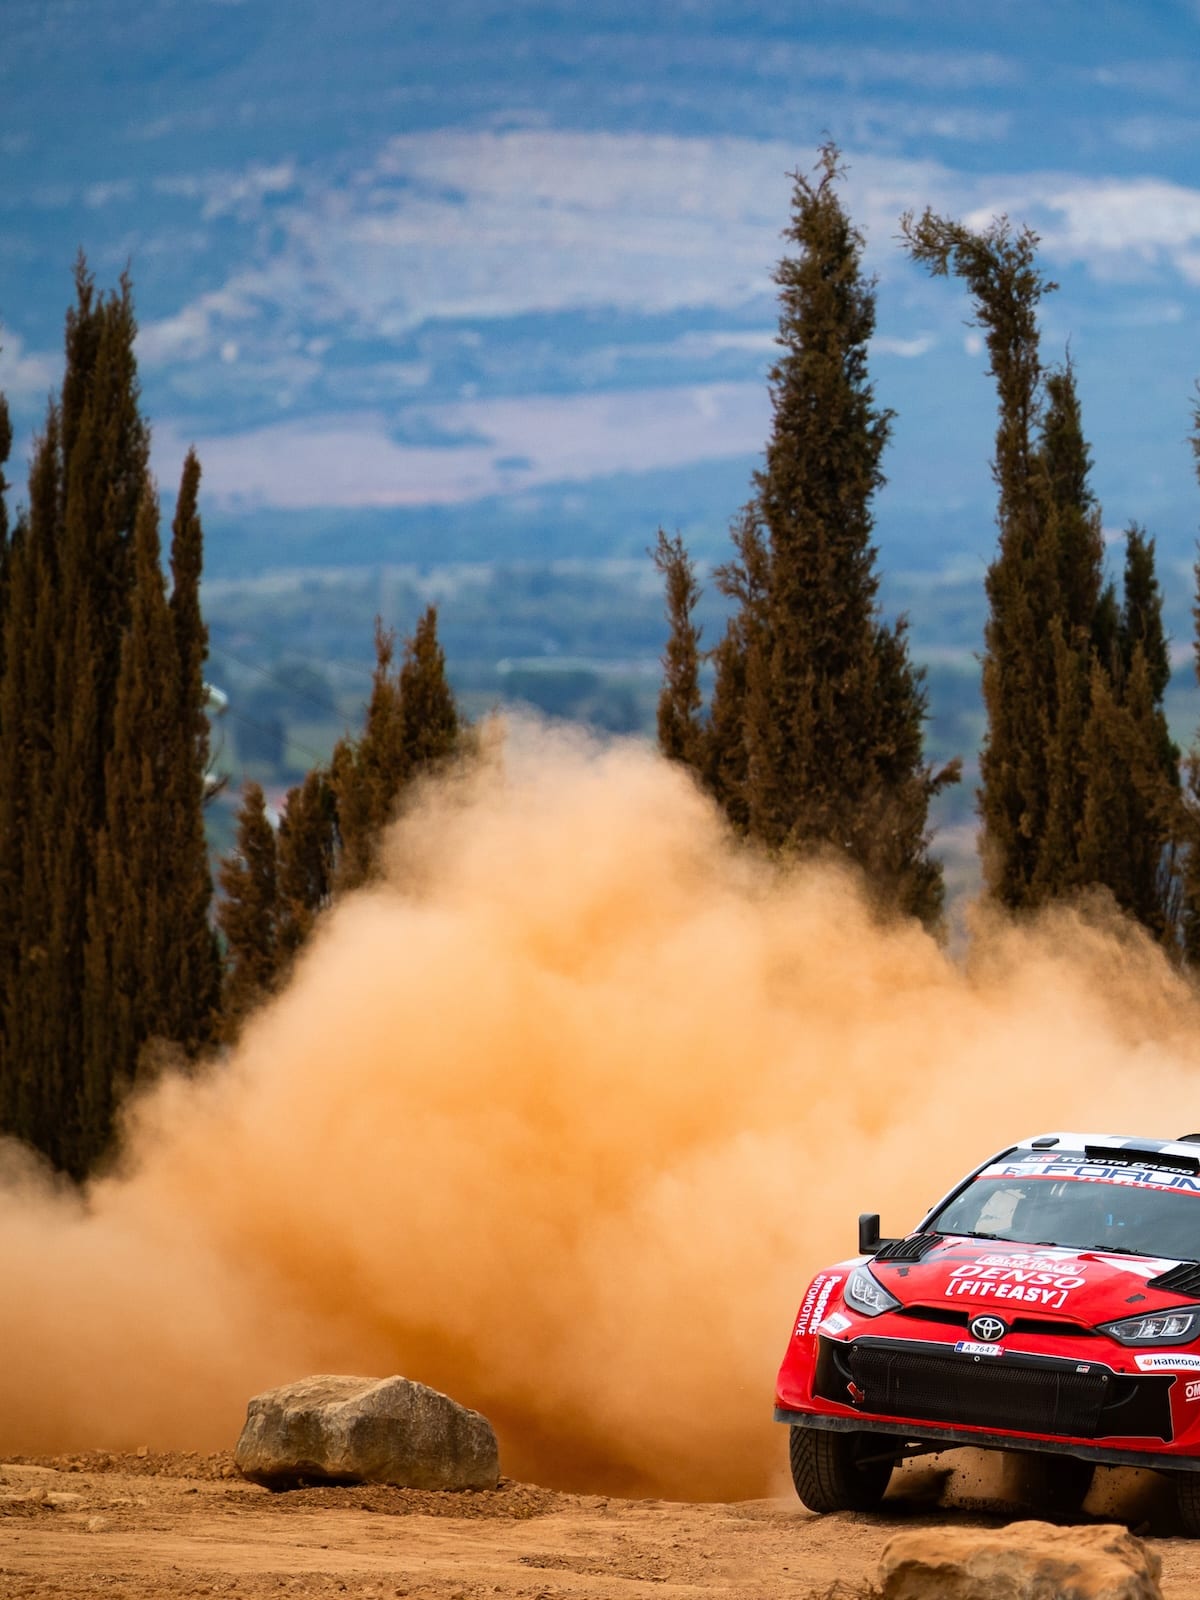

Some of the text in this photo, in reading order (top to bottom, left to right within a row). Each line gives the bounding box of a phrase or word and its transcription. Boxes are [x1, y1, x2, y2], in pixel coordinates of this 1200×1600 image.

[1062, 1157, 1127, 1166] TOYOTA
[1132, 1162, 1194, 1175] GAZOO
[949, 1265, 1086, 1290] DENSO
[795, 1274, 827, 1336] AUTOMOTIVE
[808, 1275, 843, 1335] Panasonic
[964, 1343, 996, 1354] A-7647
